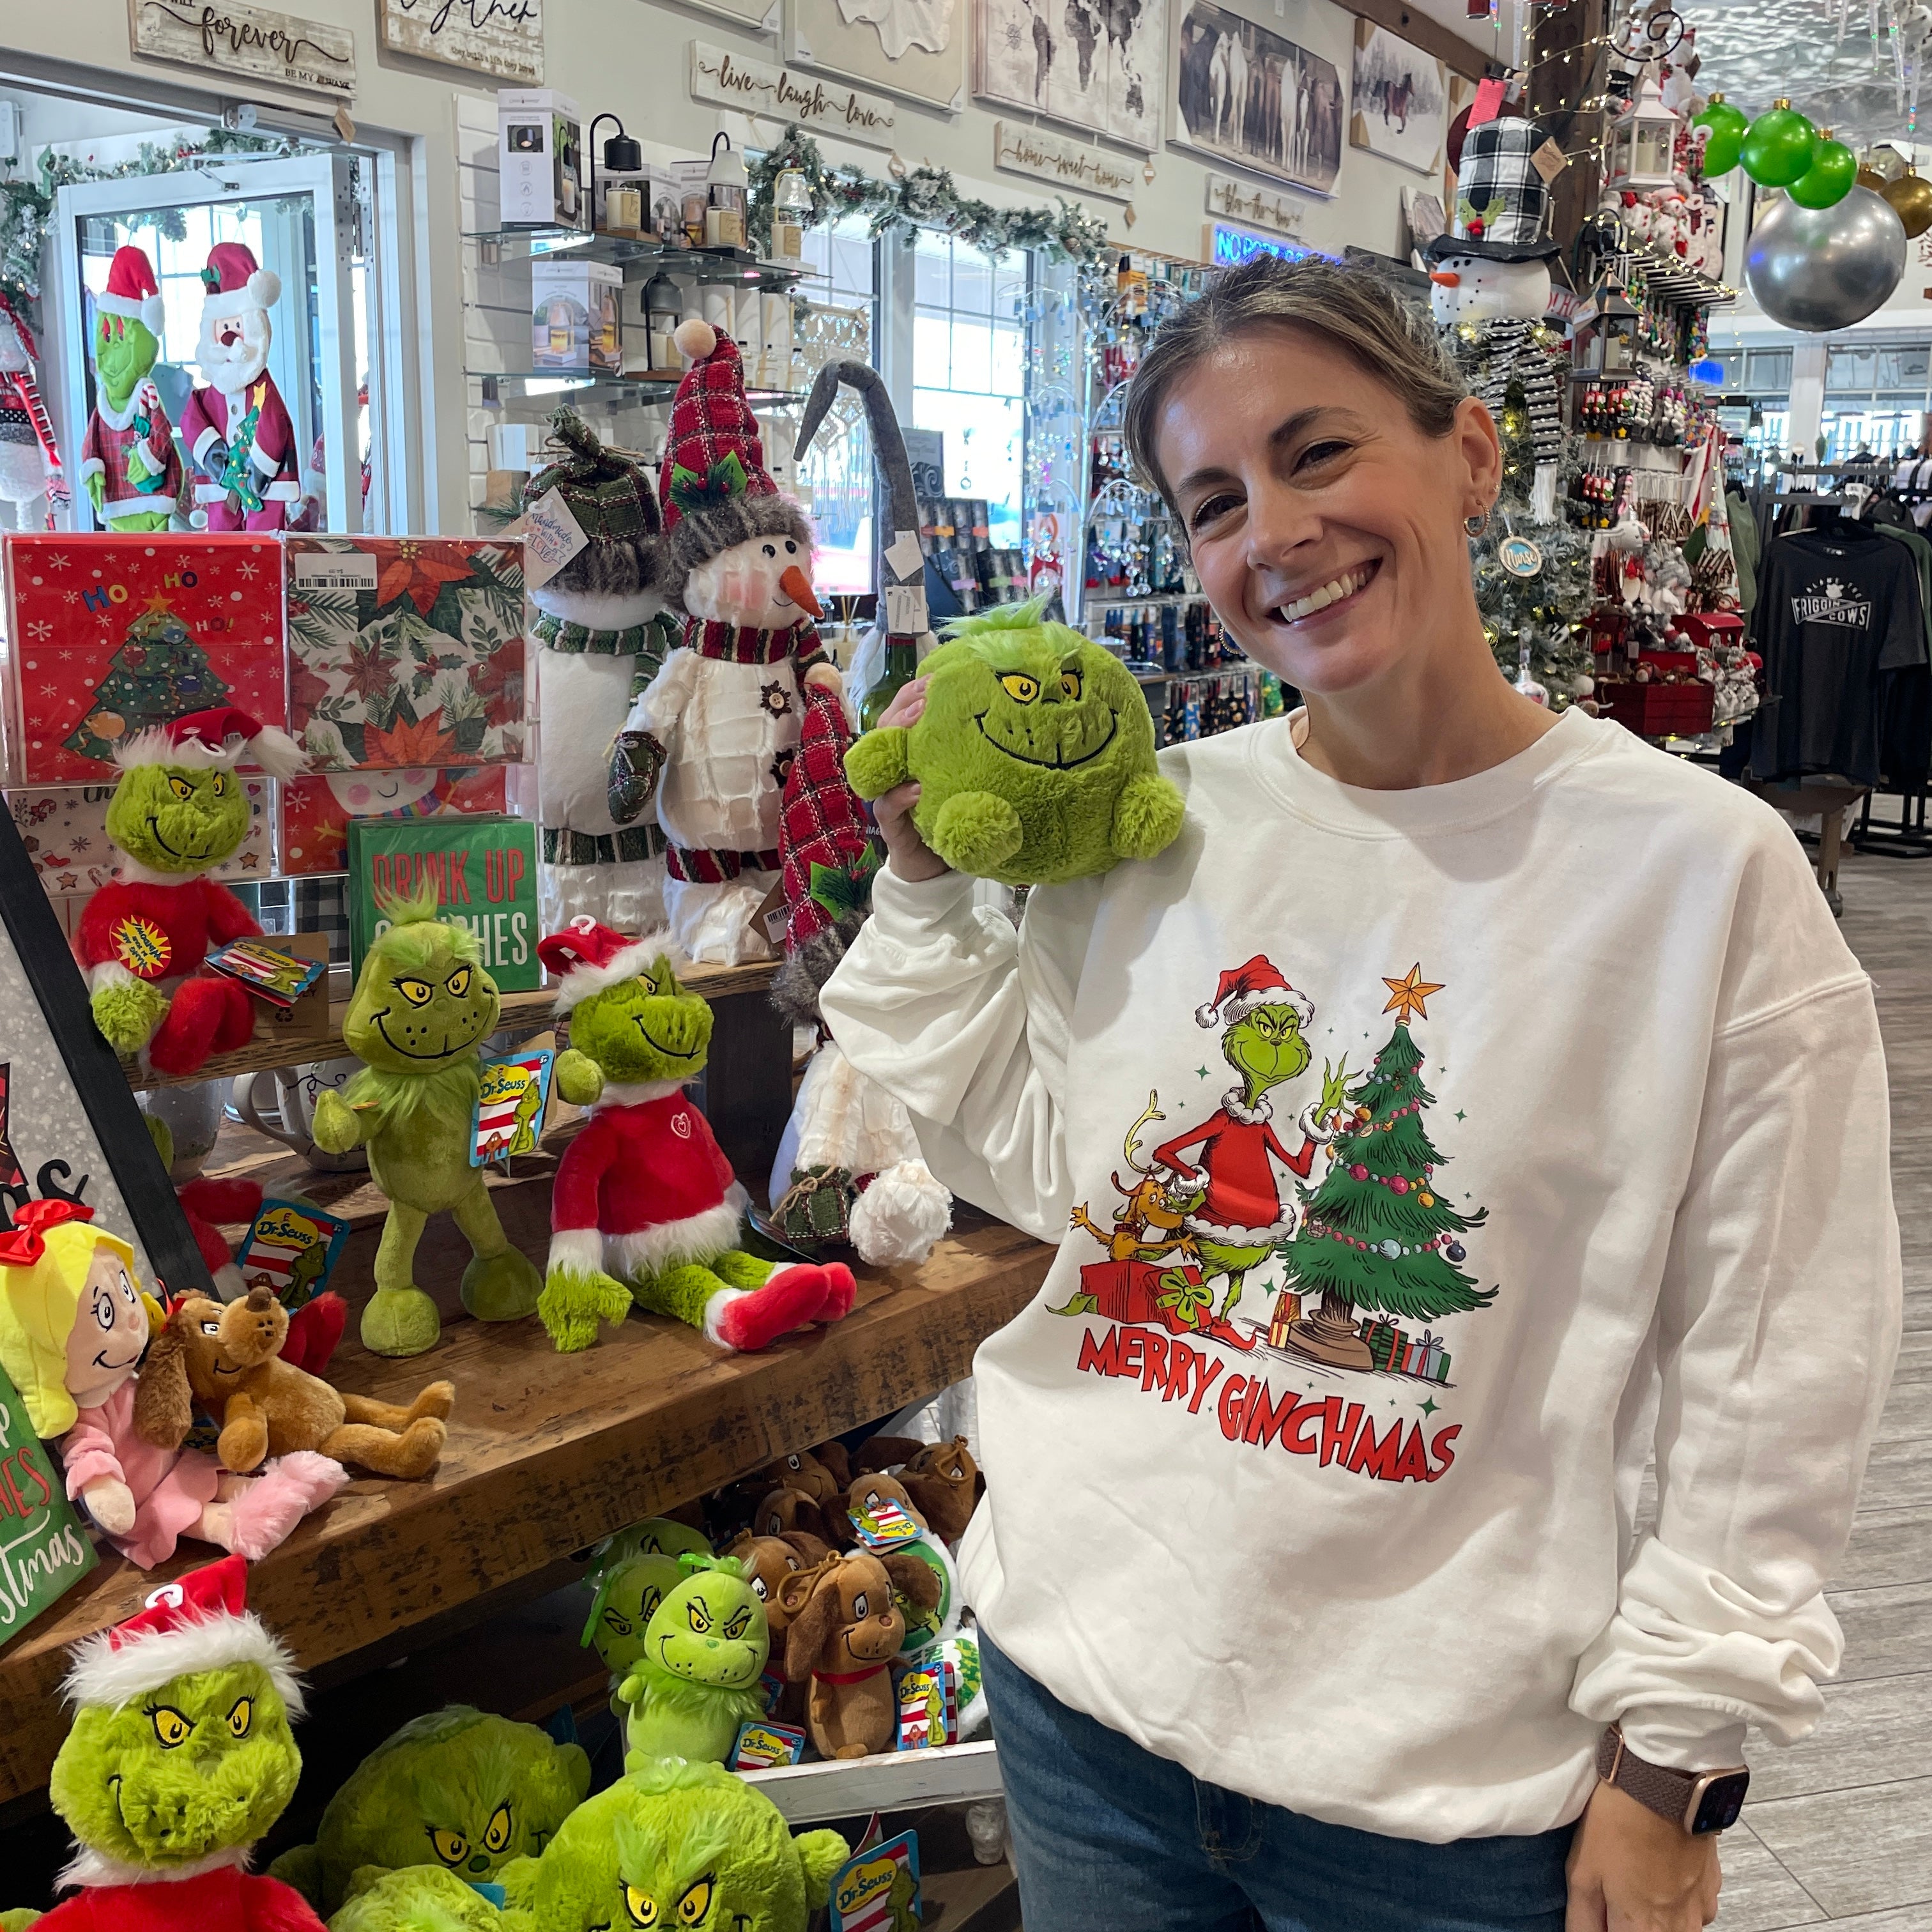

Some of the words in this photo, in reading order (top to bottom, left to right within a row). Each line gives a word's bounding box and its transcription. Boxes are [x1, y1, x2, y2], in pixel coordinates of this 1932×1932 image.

[285, 68, 297, 78] BE
[298, 70, 314, 82] MY
[721, 55, 755, 91] live
[777, 72, 825, 118] laugh
[845, 93, 882, 126] love
[541, 528, 555, 544] WITH
[164, 571, 198, 588] HO
[82, 585, 128, 613] HO
[195, 617, 234, 633] HO!
[1828, 605, 1867, 626] COWS
[372, 850, 471, 910] DRINK
[485, 848, 525, 903] UP
[496, 1078, 525, 1094] Seuss
[277, 1222, 313, 1245] Seuss
[1077, 1325, 1225, 1414] MERRY
[910, 1682, 930, 1694] Seuss
[756, 1739, 781, 1755] Seuss
[858, 1870, 893, 1897] Seuss
